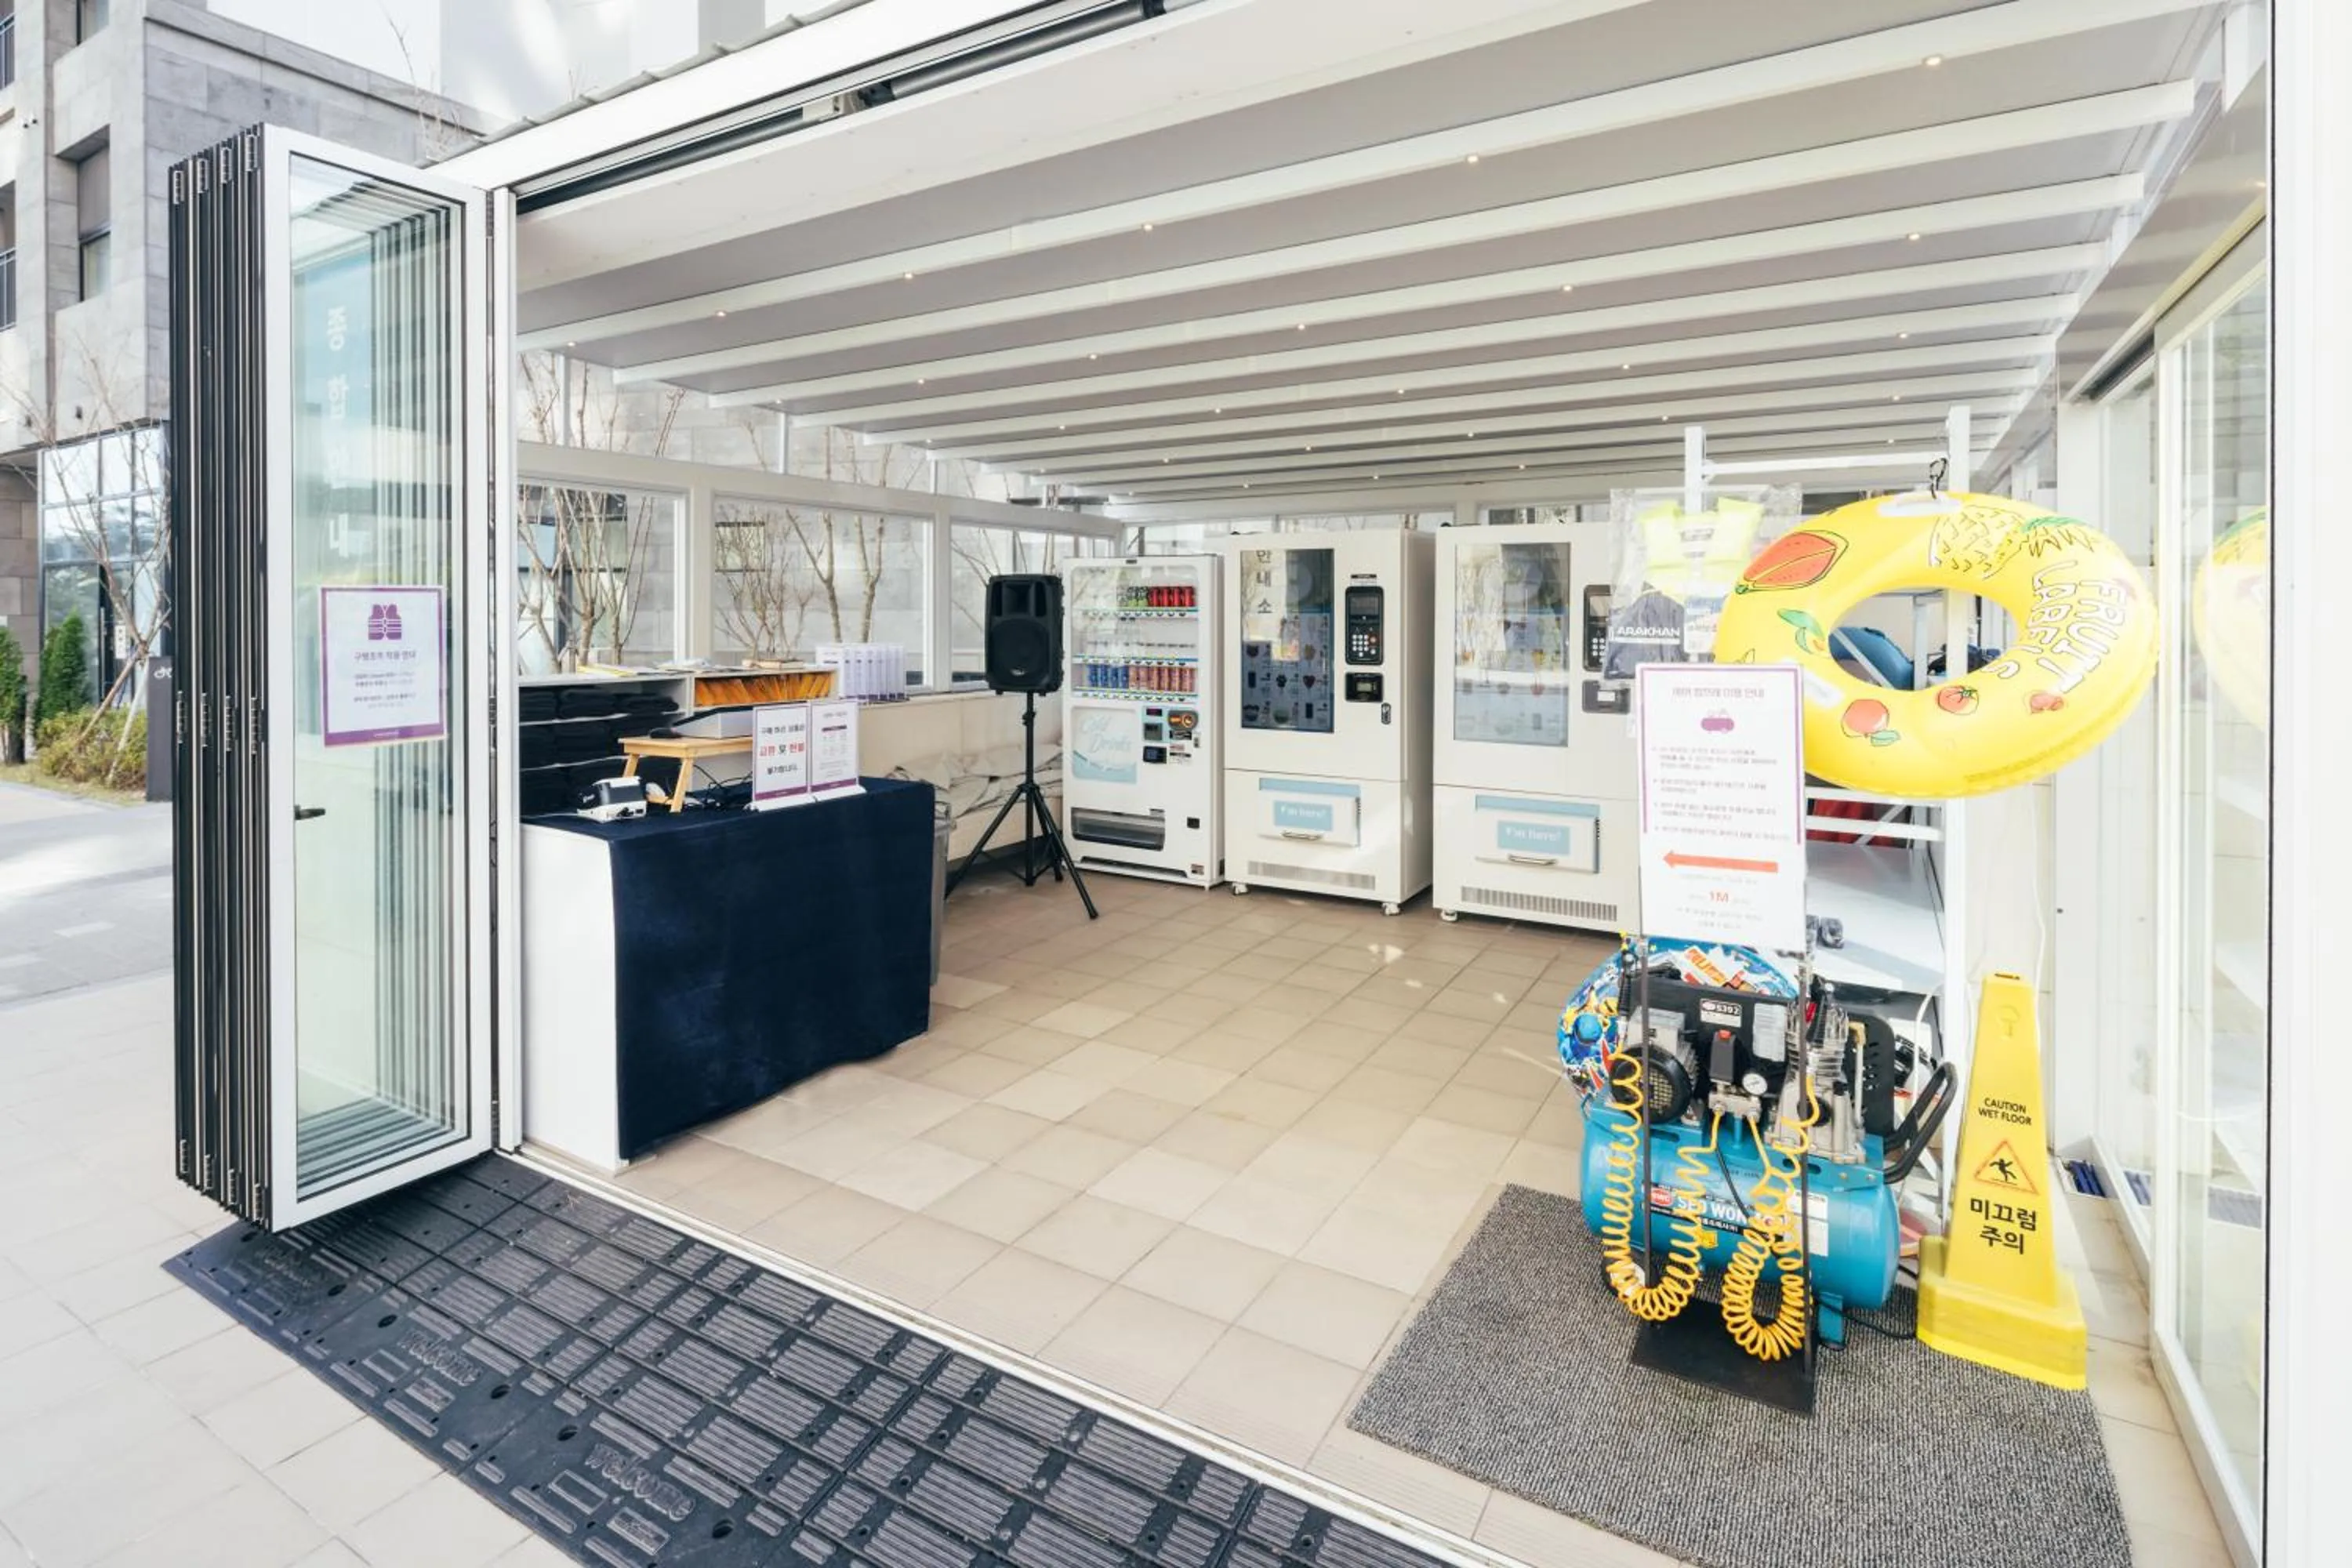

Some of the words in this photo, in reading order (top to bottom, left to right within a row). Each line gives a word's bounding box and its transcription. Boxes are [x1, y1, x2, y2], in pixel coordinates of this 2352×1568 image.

[2036, 579, 2127, 695] FRUIT
[1977, 1107, 1999, 1119] WET
[2001, 1111, 2032, 1126] FLOOR
[1984, 1098, 2027, 1114] CAUTION
[1969, 1197, 2036, 1232] 미끄럼
[1980, 1225, 2024, 1255] 주의
